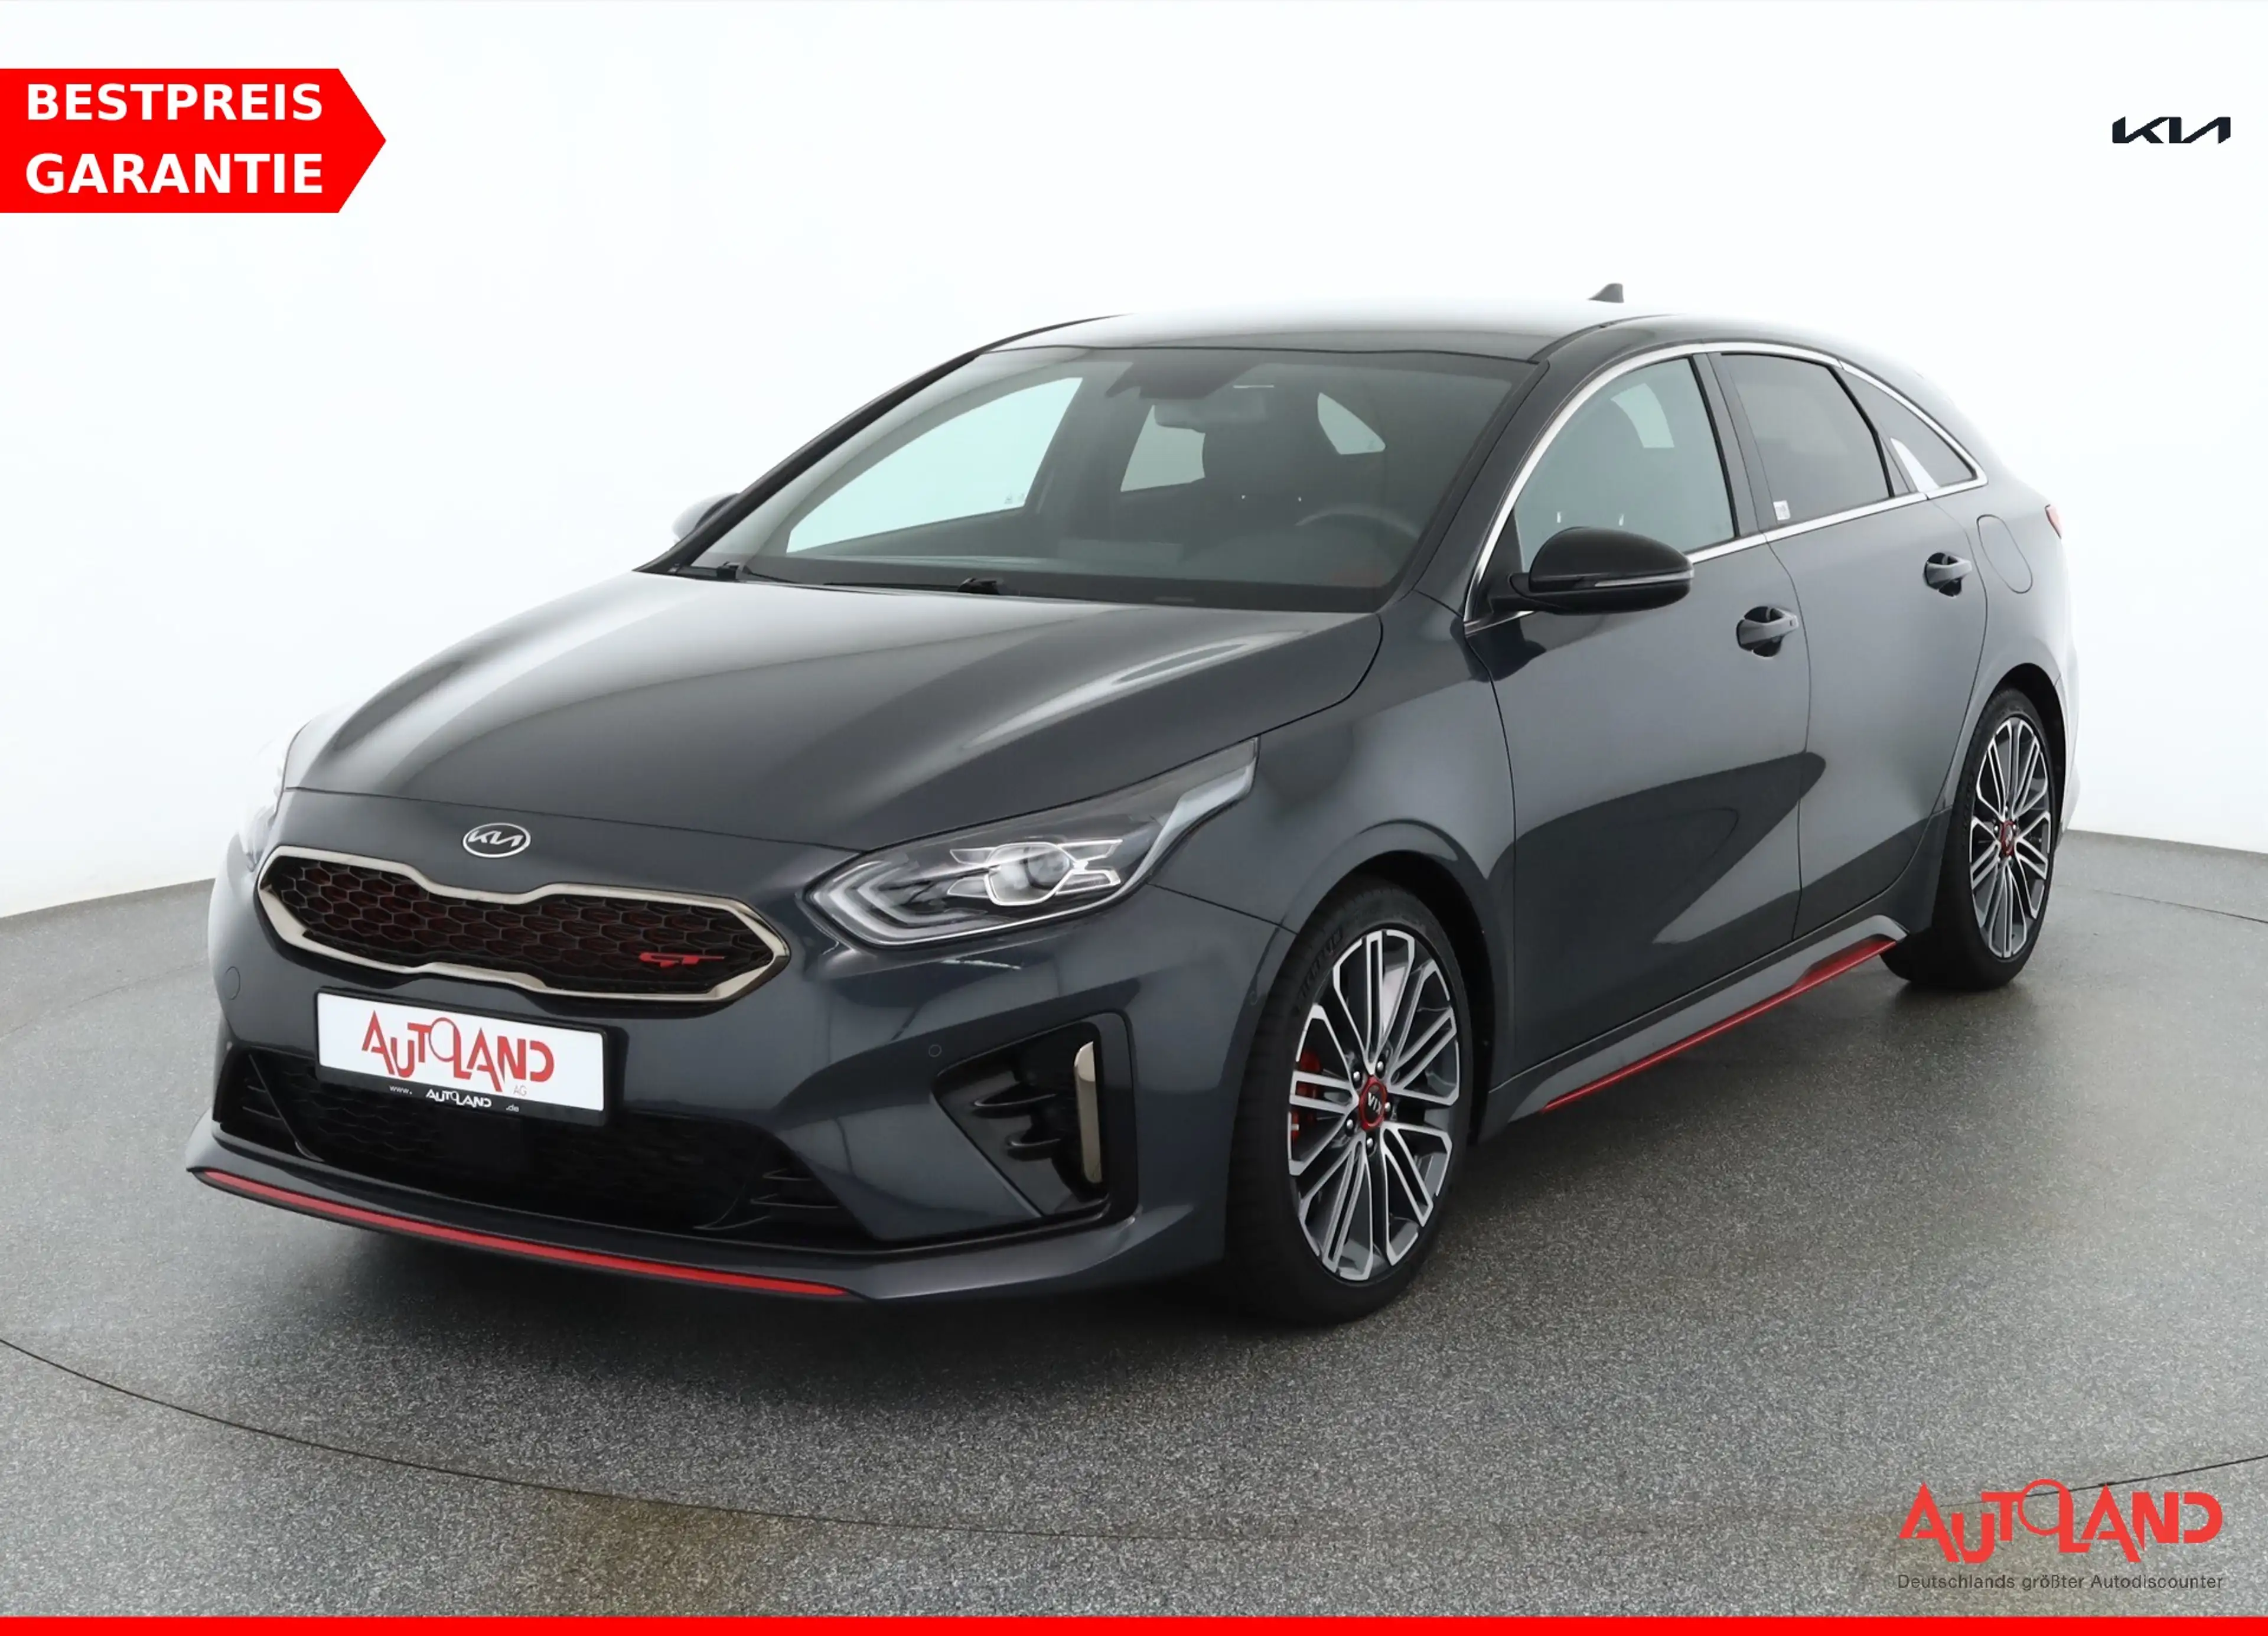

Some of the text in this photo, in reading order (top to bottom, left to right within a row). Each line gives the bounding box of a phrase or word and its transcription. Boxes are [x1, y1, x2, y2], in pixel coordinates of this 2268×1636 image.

[468, 830, 524, 848] KIA
[639, 952, 726, 968] GT
[361, 1010, 555, 1093] AUTOLAND
[513, 1085, 527, 1097] AG
